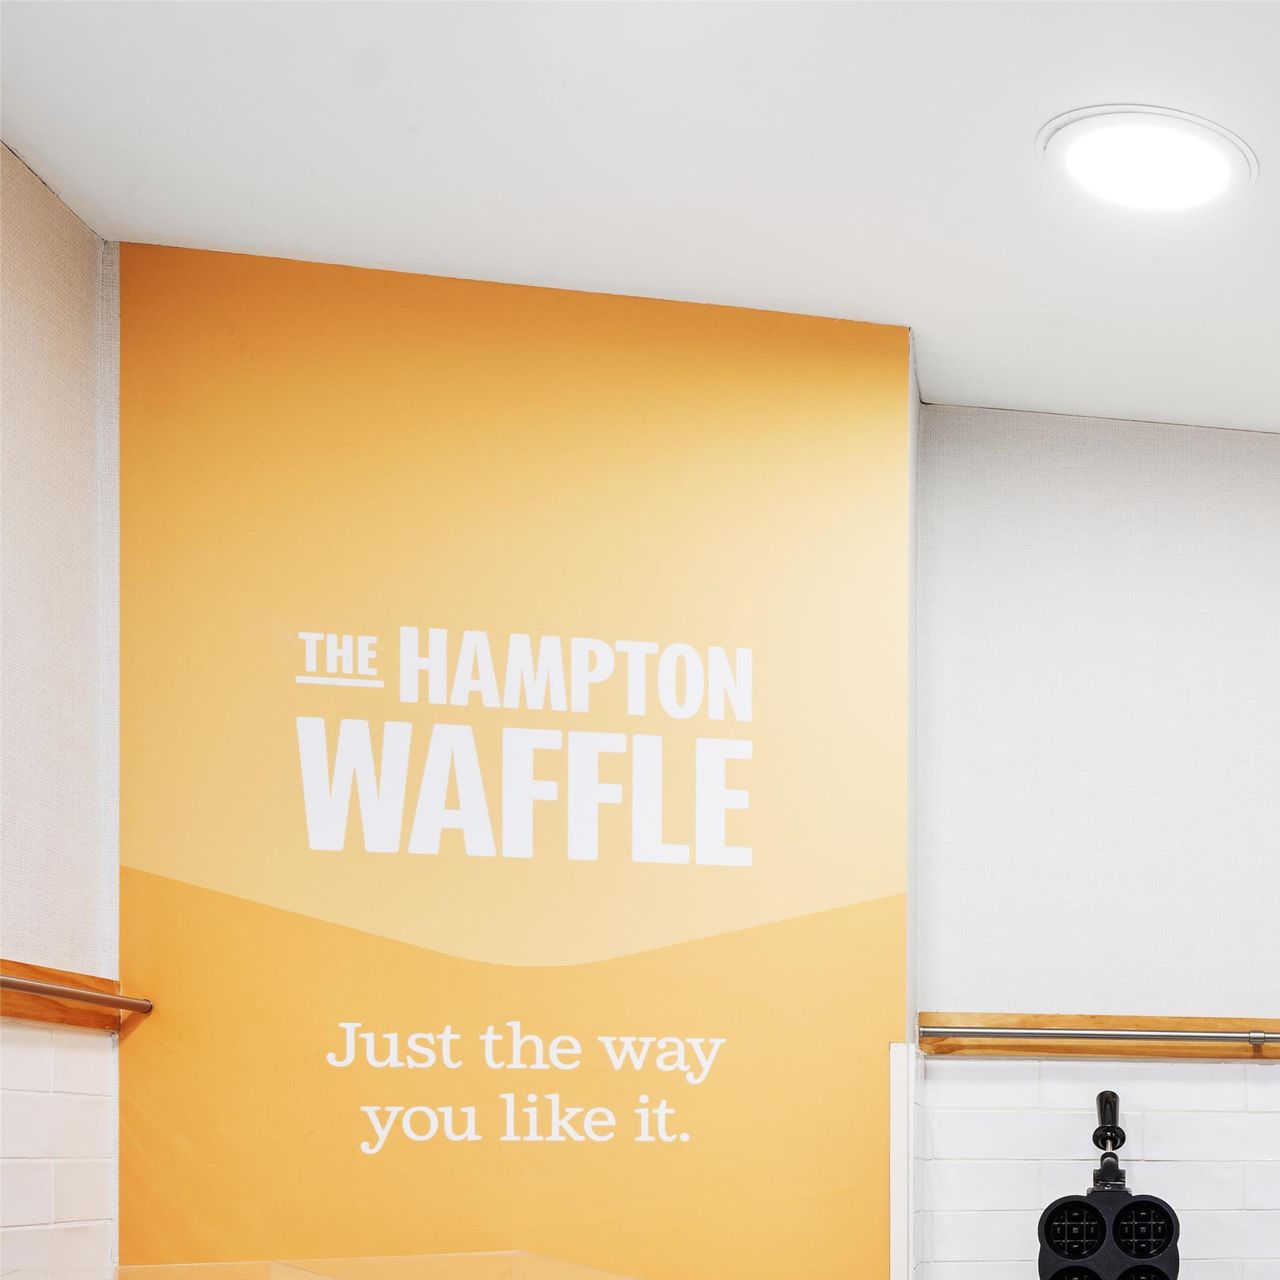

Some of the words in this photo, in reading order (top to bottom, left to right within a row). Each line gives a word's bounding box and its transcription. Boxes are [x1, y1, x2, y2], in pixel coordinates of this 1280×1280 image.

[298, 632, 378, 676] THE
[399, 626, 753, 722] HAMPTON
[296, 716, 753, 866] WAFFLE
[326, 1022, 463, 1070] Just
[479, 1021, 582, 1070] the
[598, 1036, 727, 1085] way
[360, 1105, 482, 1155] you
[499, 1093, 616, 1142] like
[634, 1094, 691, 1142] it.
